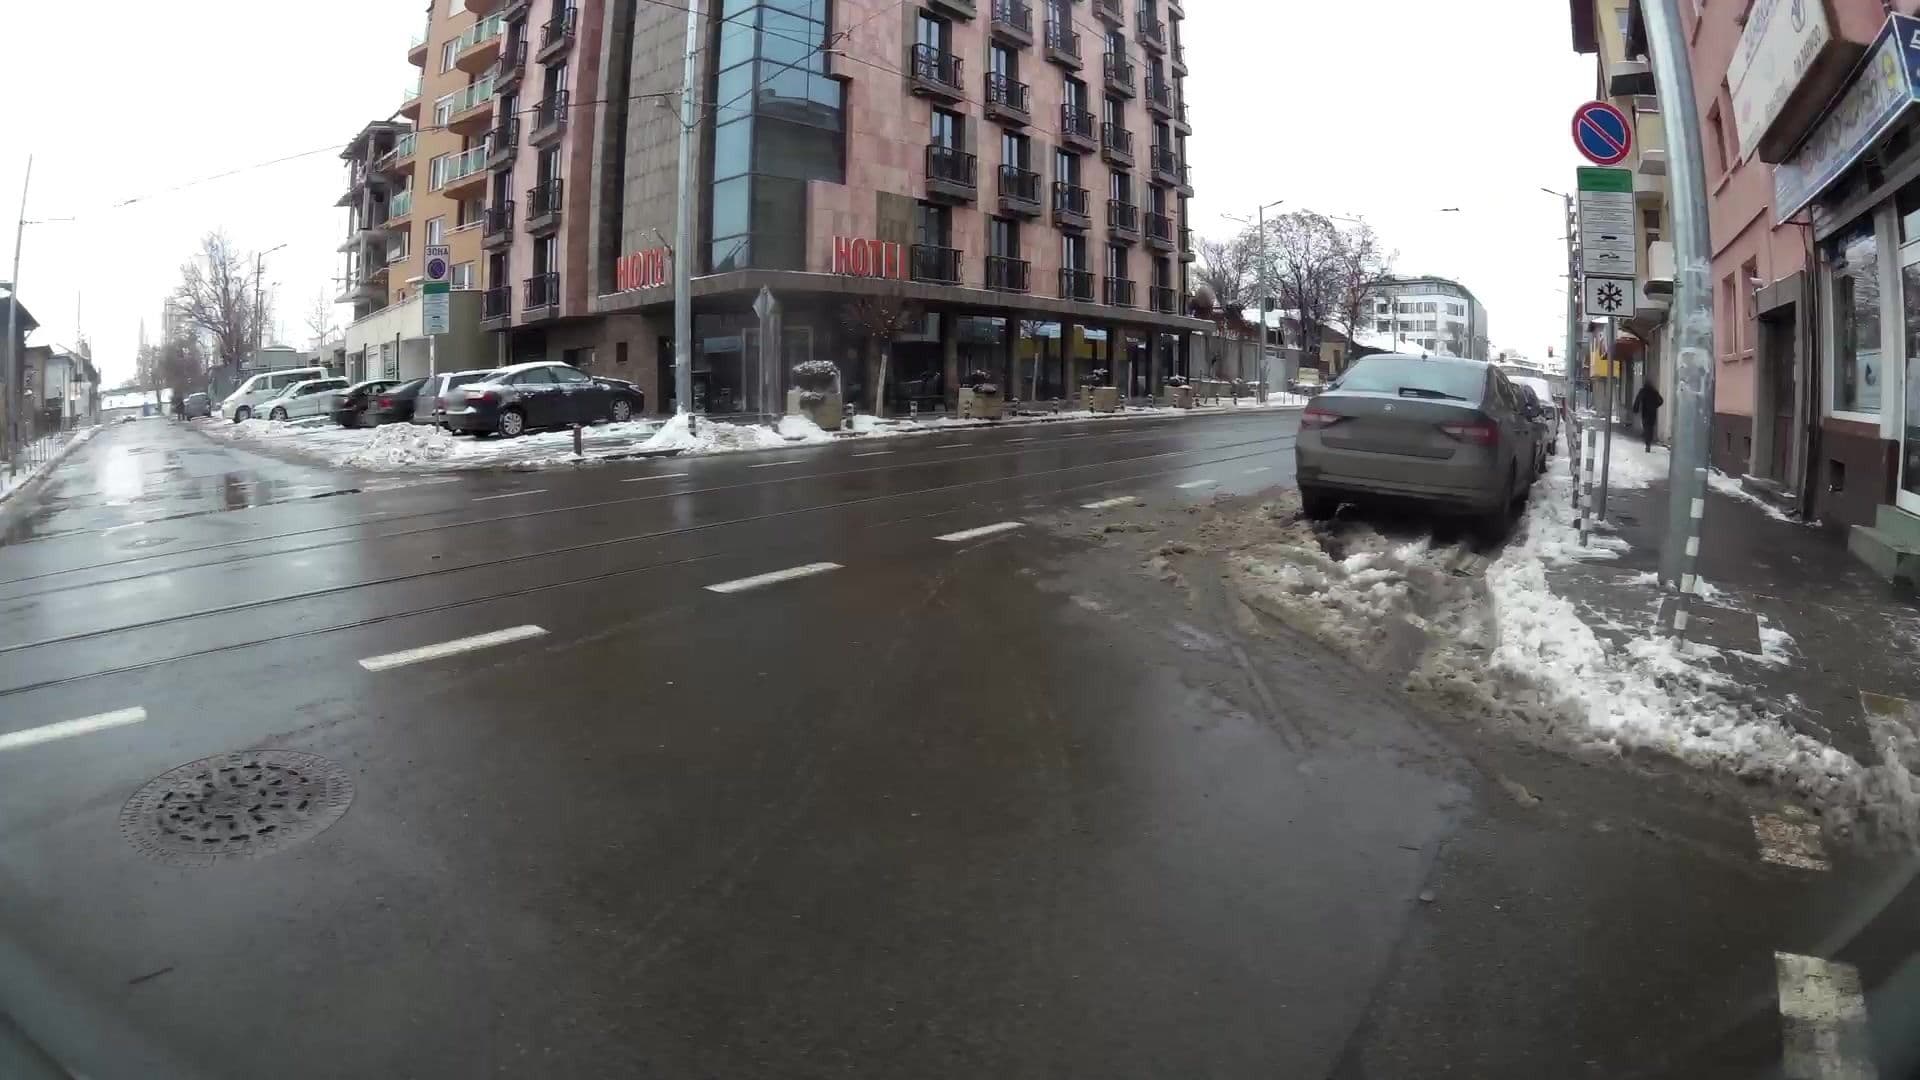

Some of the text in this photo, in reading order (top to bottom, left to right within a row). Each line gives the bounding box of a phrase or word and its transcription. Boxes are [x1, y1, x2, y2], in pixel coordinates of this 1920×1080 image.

[426, 247, 449, 256] ЗОНА
[617, 248, 666, 292] HOTE
[832, 235, 910, 280] HOTEL
